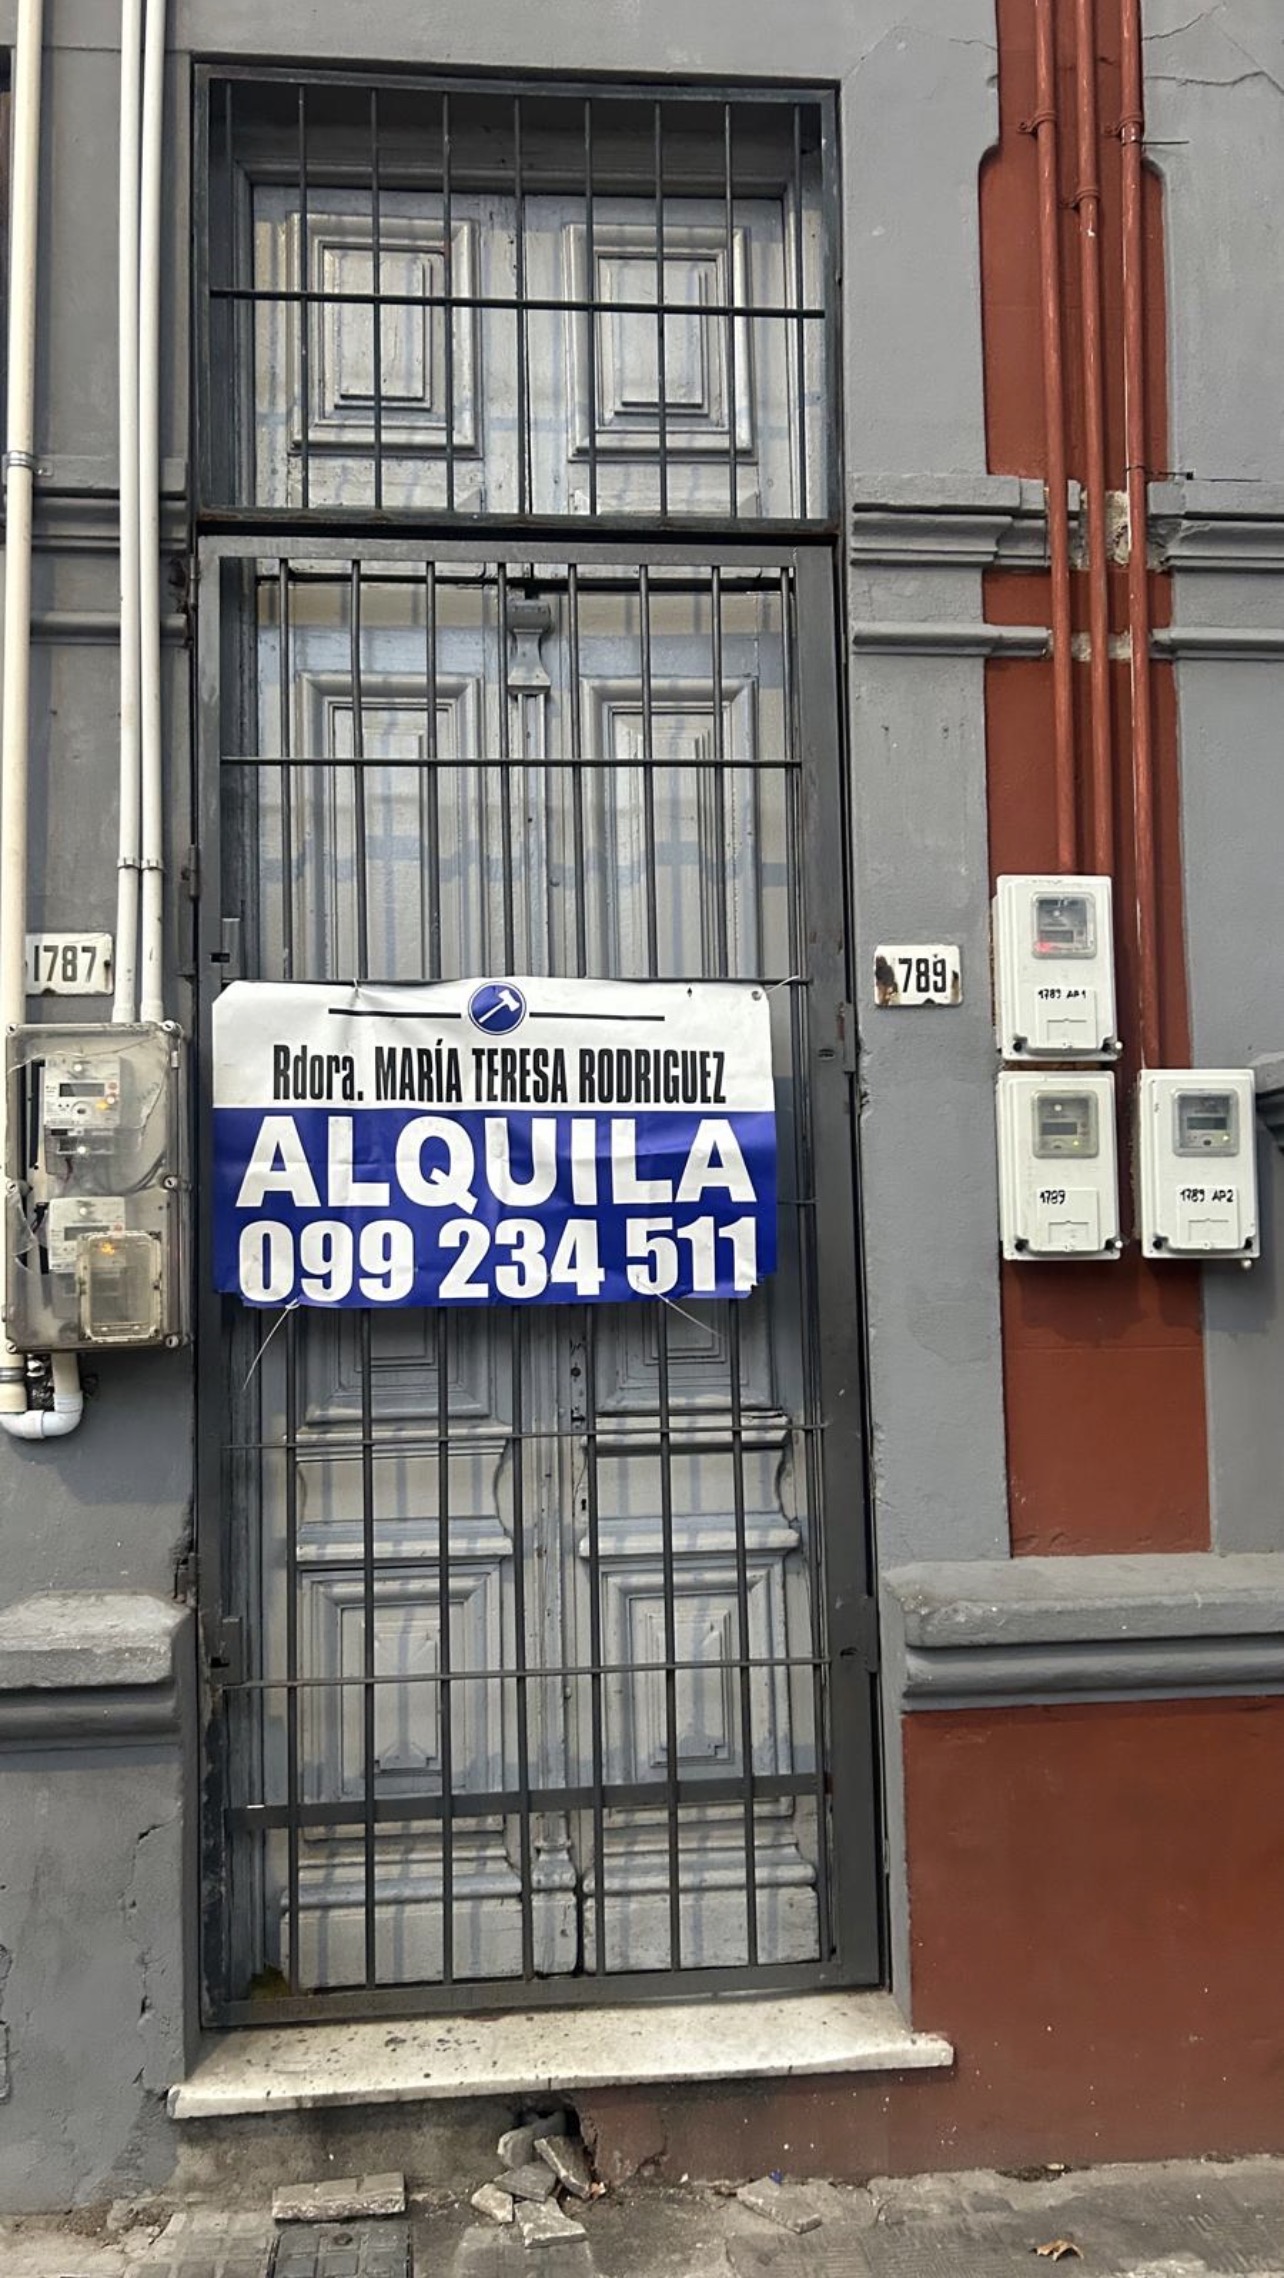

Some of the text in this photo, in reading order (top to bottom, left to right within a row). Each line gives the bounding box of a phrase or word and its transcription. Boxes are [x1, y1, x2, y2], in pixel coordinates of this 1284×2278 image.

[34, 945, 97, 982] 1787
[273, 1038, 726, 1105] Rdora. MARÍA TERESA RODRIGUEZ
[235, 1115, 757, 1214] ALQUILA
[1040, 1189, 1066, 1205] 1789
[1180, 1188, 1234, 1203] 1789 AP2
[238, 1215, 757, 1302] 099 234 511
